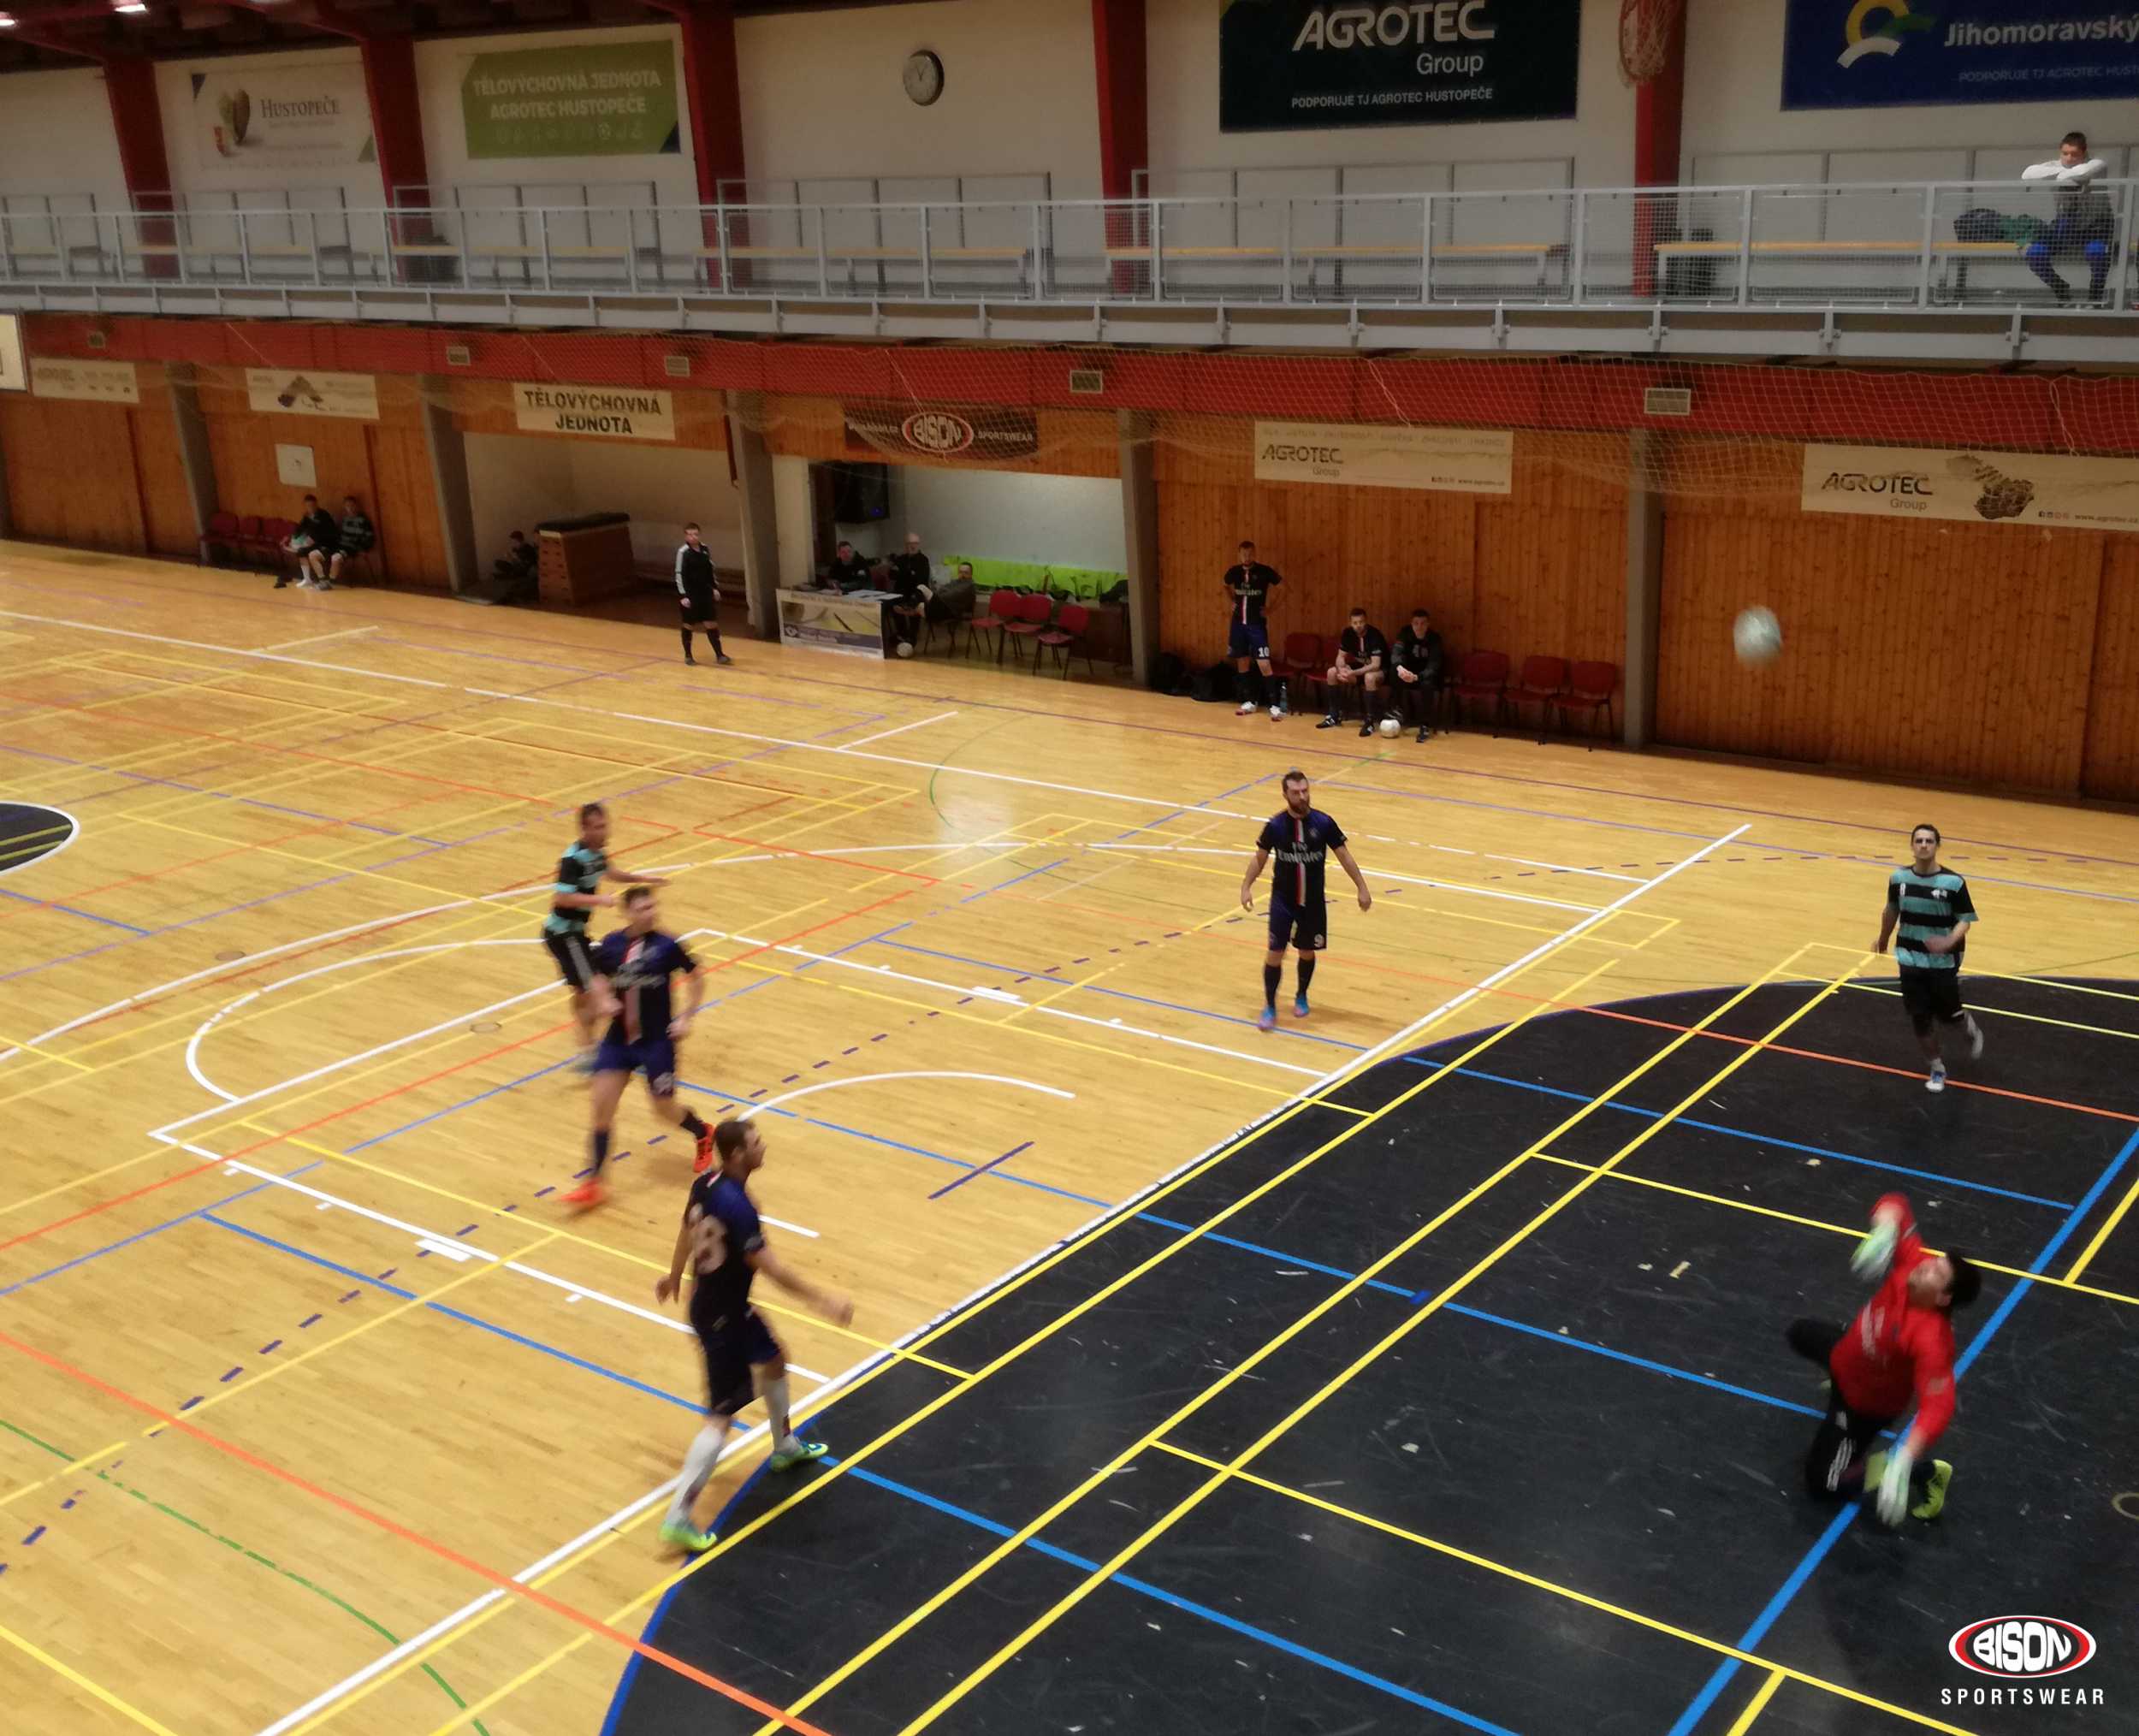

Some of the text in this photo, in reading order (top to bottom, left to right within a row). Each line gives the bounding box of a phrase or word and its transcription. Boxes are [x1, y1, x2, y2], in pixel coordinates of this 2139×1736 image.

[1292, 0, 1495, 51] AGROTEC
[1416, 52, 1484, 77] Group
[1958, 68, 2029, 83] PODPORUJE
[2032, 67, 2047, 80] TJ
[2047, 64, 2104, 80] AGROTEC
[591, 70, 662, 89] JEDNOTA
[1291, 86, 1493, 108] PODPORUJE TJ AGROTEC HUSTOPEČE
[490, 103, 560, 120] AGROTEC
[524, 388, 662, 415] TĚLOVÝCHOVNÁ
[555, 414, 633, 434] JEDNOTA
[913, 416, 962, 448] BISON
[1262, 444, 1344, 465] AGROTEC
[1312, 466, 1340, 477] Group
[1822, 472, 1933, 495] AGROTEC
[1890, 498, 1927, 512] Group
